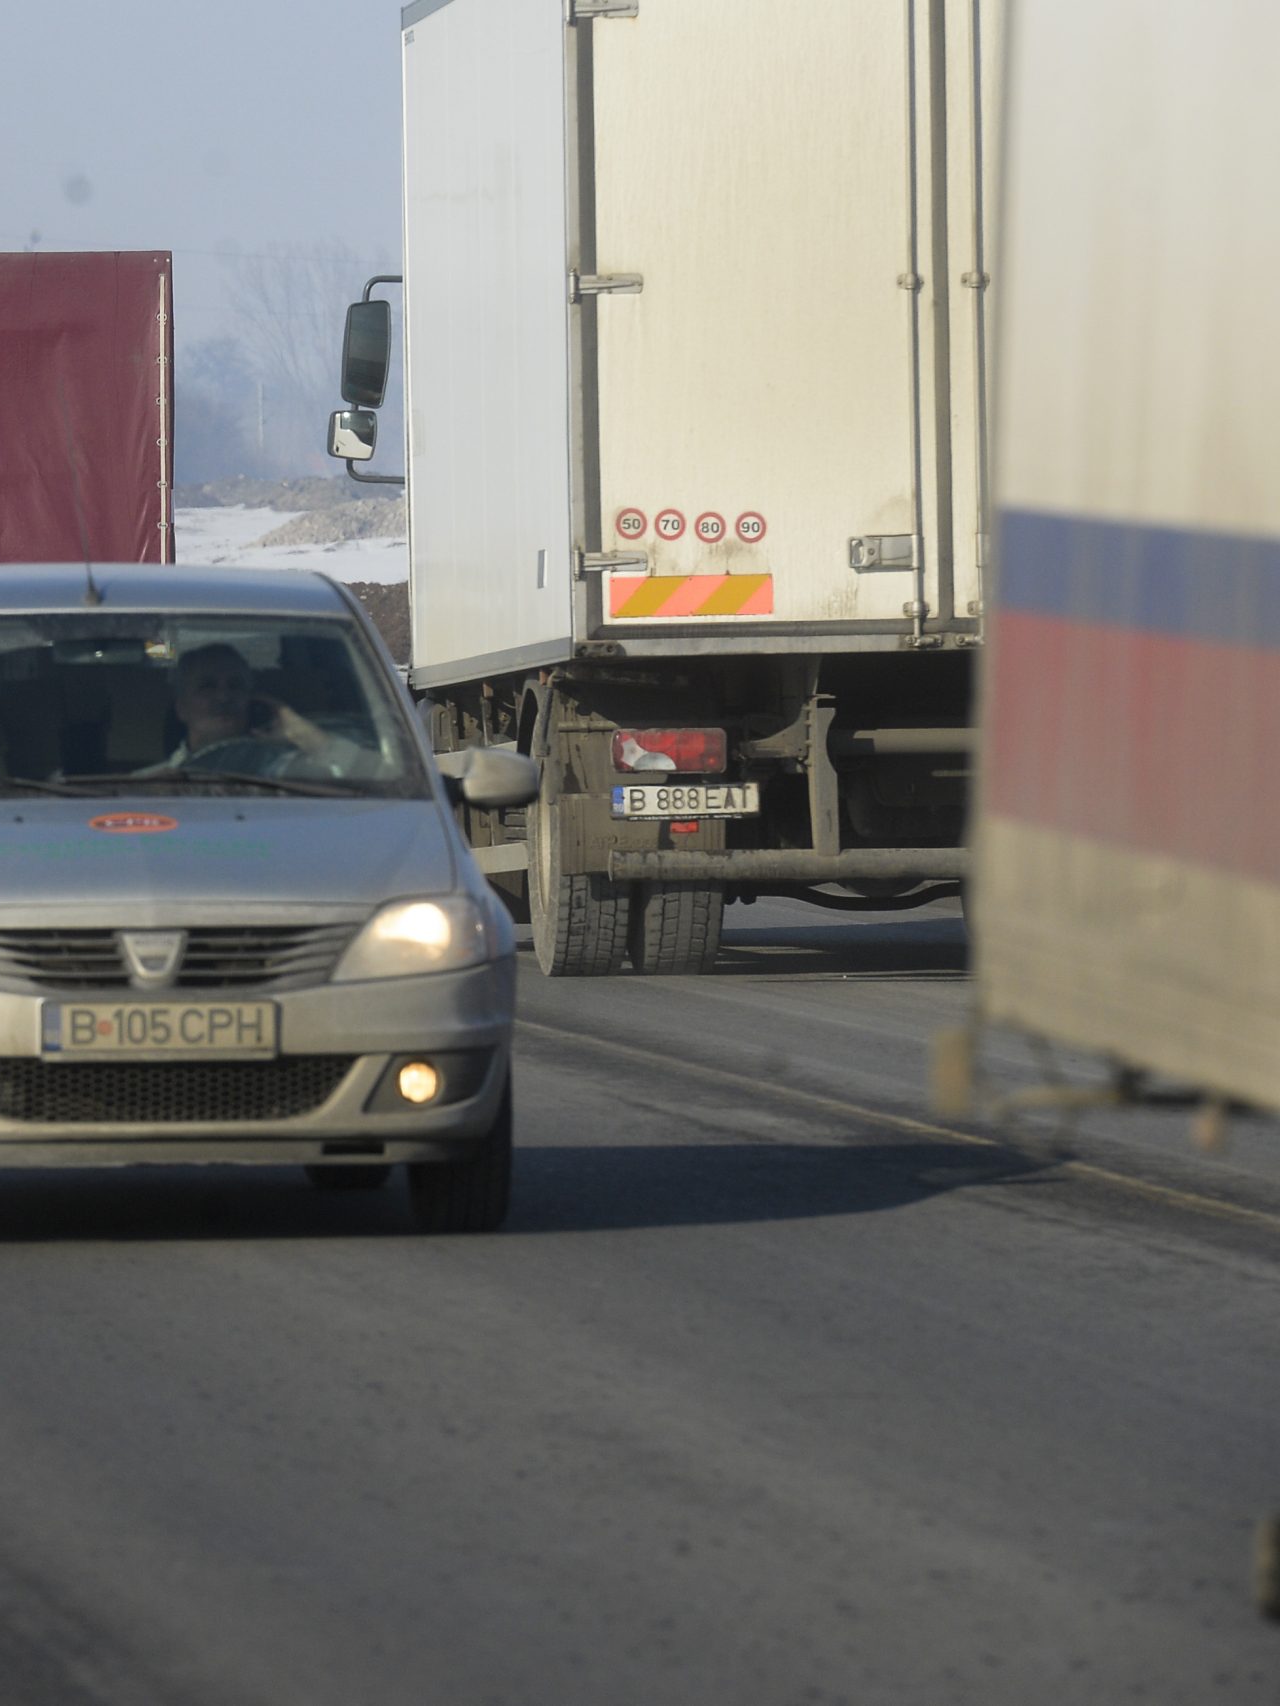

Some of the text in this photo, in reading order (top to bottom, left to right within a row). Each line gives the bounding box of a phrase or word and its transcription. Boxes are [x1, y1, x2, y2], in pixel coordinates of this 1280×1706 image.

[622, 518, 641, 530] 50
[661, 519, 680, 531] 70
[701, 522, 720, 534] 80
[741, 521, 760, 533] 90
[629, 784, 751, 812] B 888 EAT
[71, 1009, 263, 1045] B 105 CPH
